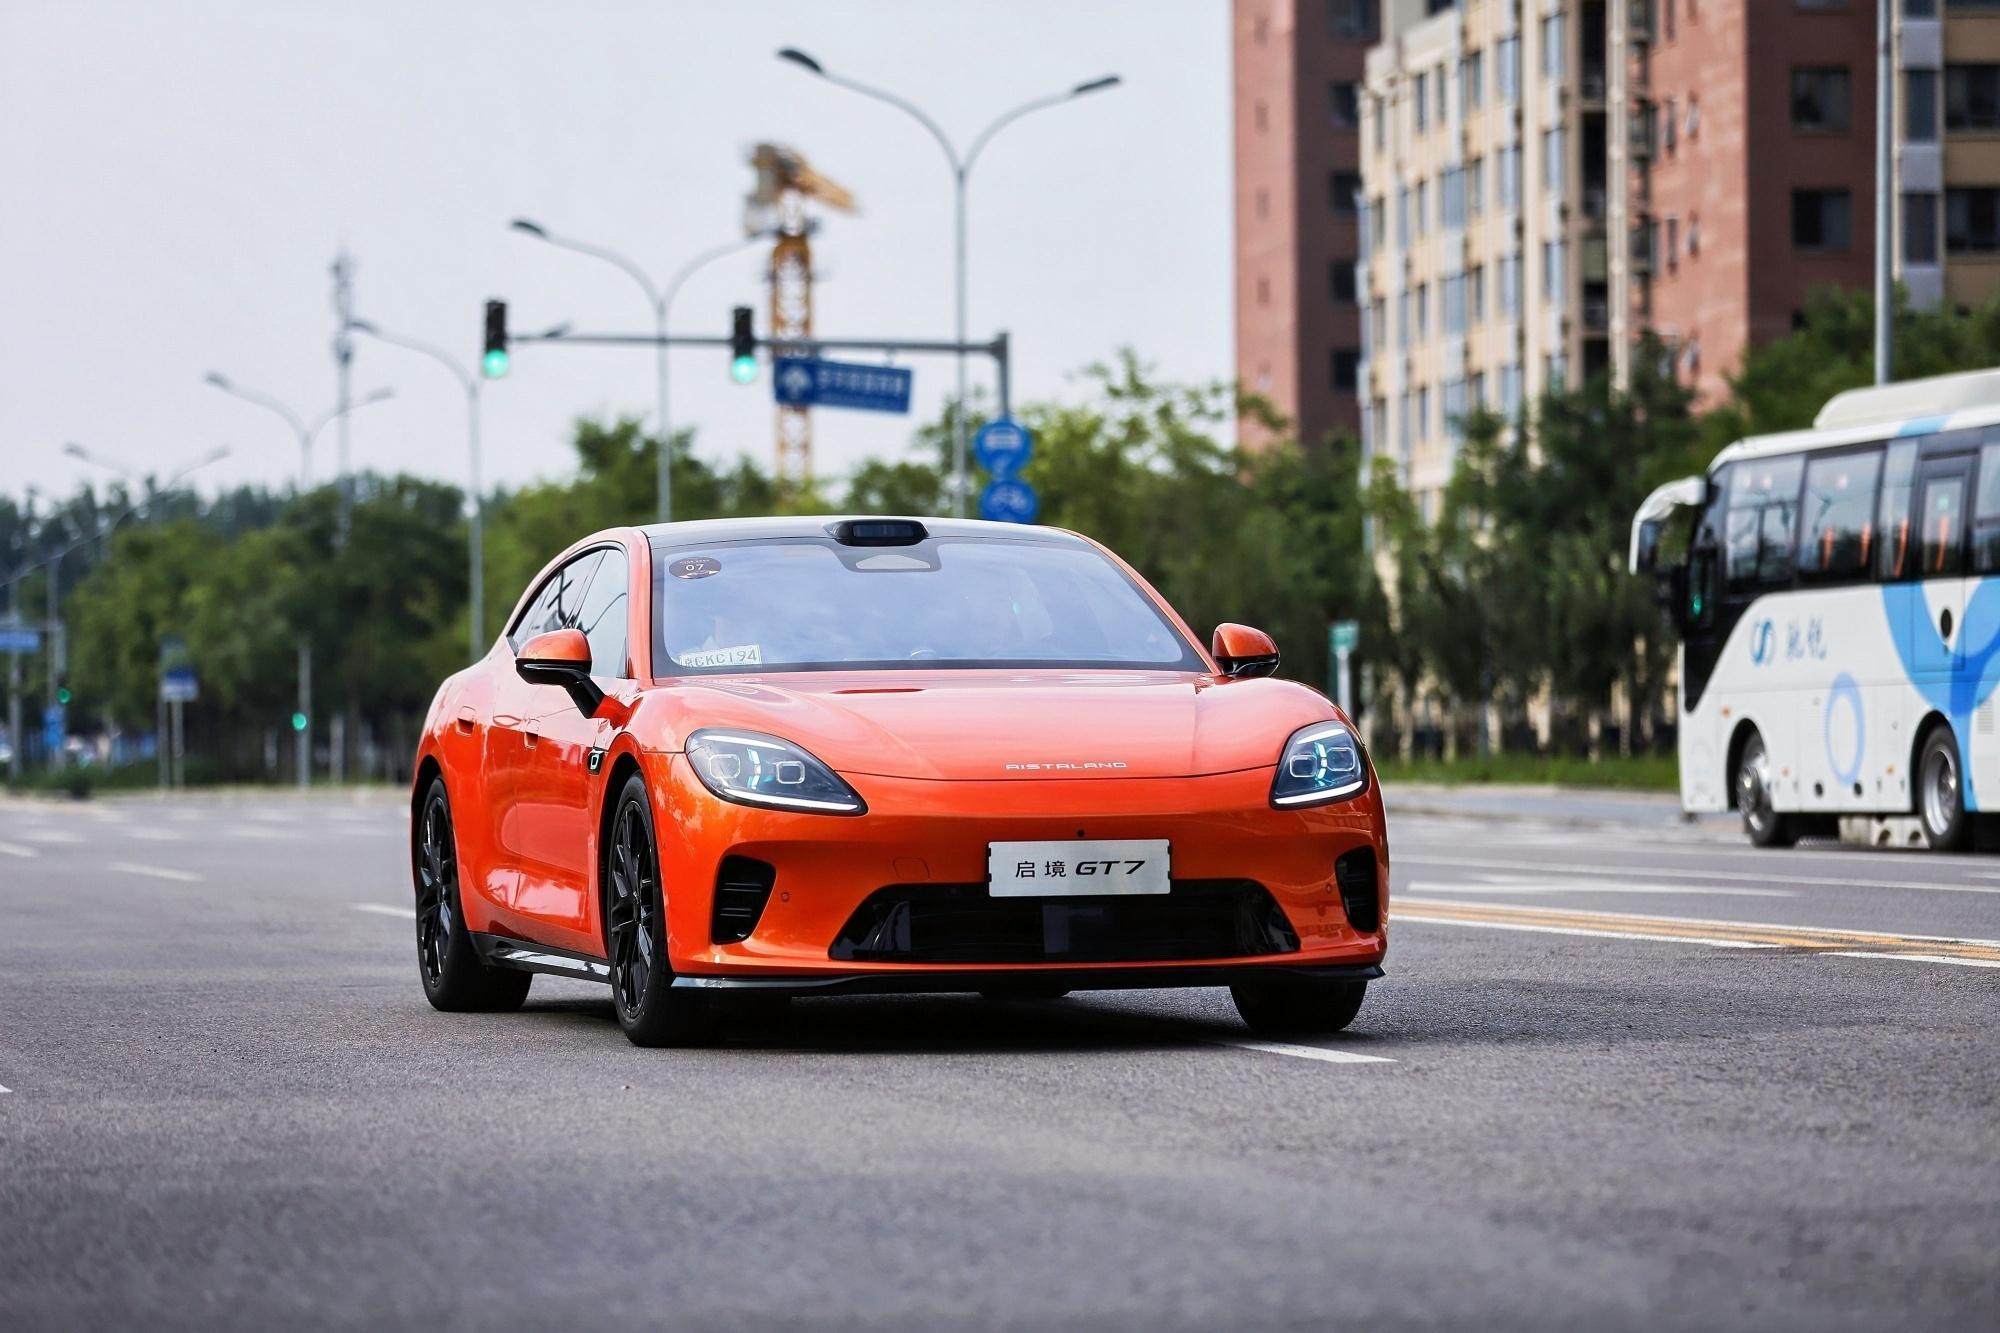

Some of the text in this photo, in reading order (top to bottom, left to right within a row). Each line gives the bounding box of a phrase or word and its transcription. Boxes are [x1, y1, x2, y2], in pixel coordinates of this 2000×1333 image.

[685, 563, 704, 571] 07
[1005, 762, 1127, 770] AISTALAND
[1015, 860, 1146, 878] 启境 GT7
